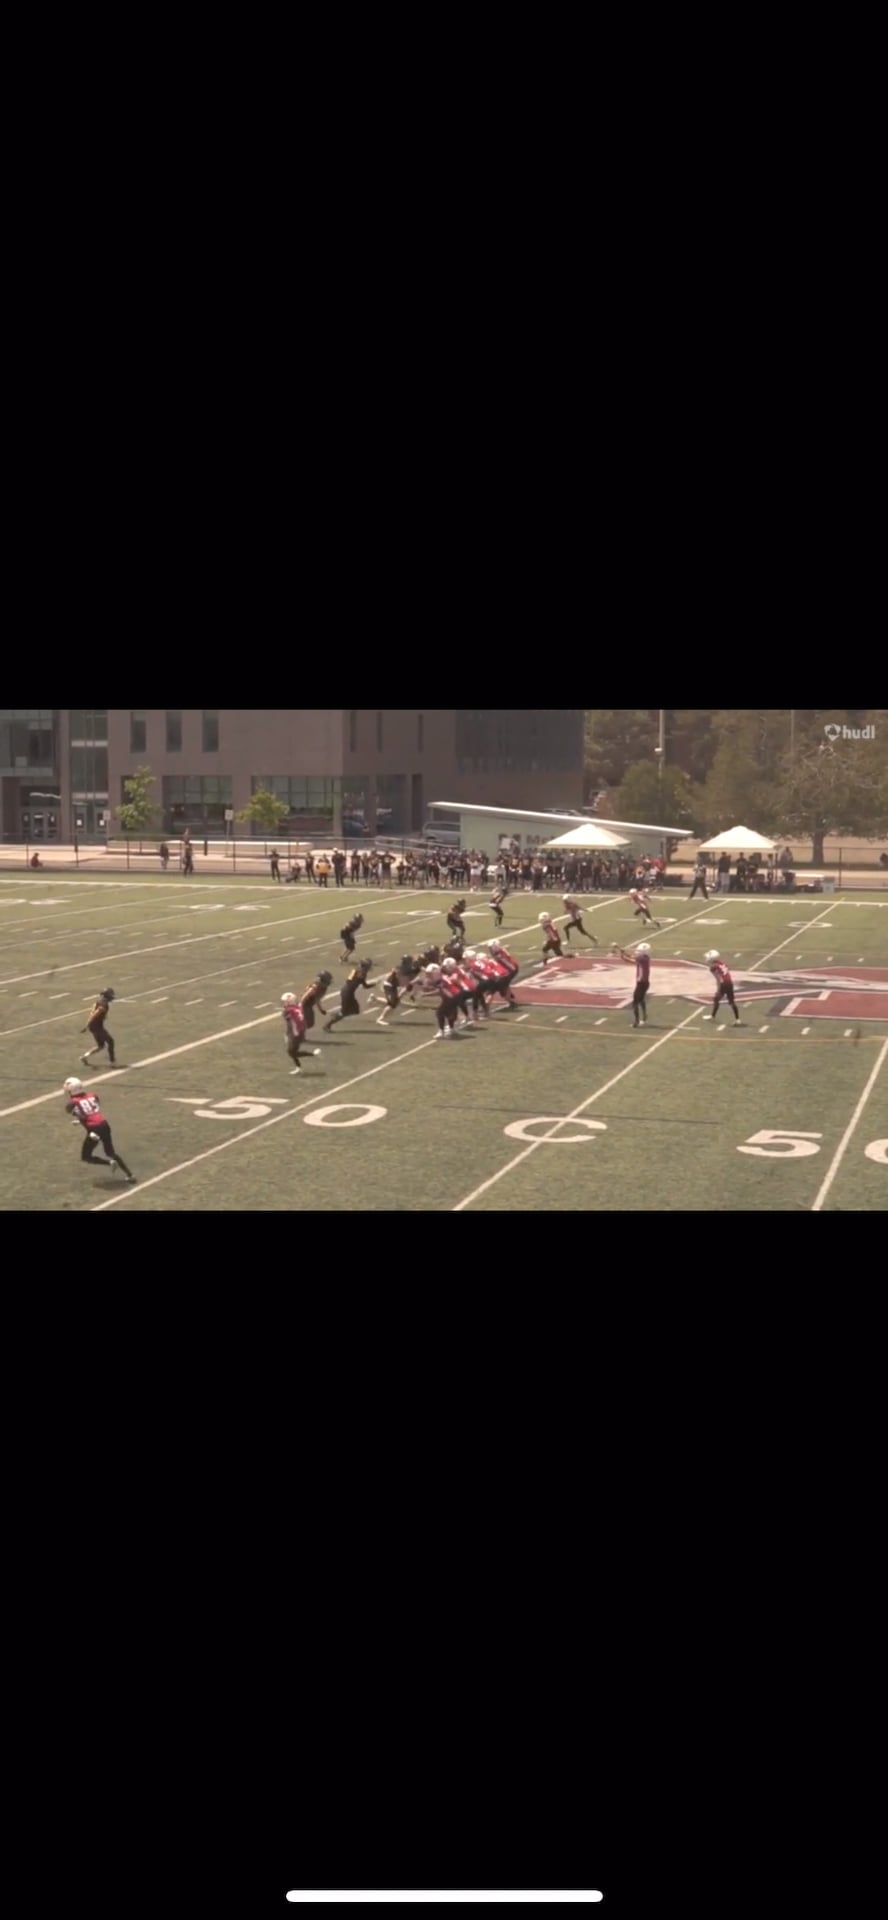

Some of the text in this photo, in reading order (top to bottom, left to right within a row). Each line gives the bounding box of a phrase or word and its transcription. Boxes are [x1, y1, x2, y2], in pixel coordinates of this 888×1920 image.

[79, 1097, 100, 1116] 85
[193, 1095, 388, 1128] 50
[503, 1116, 608, 1143] C
